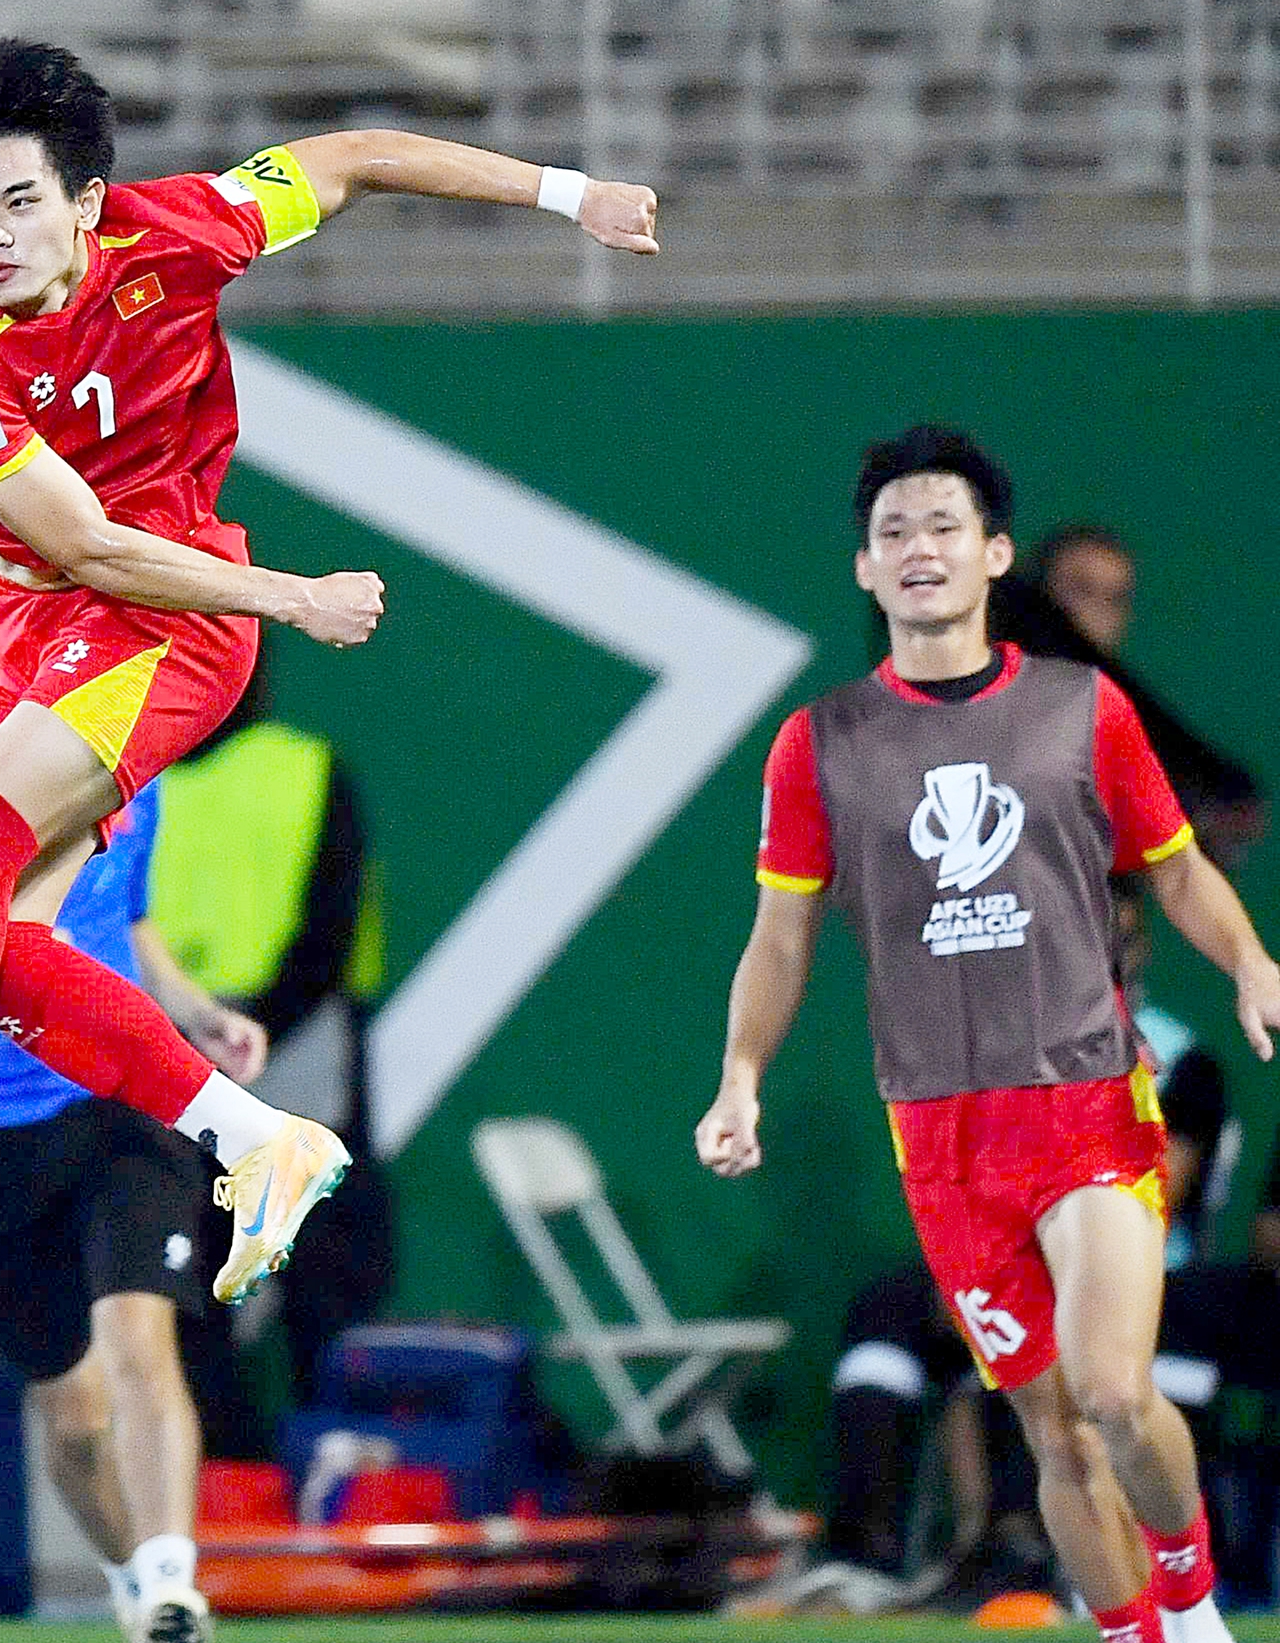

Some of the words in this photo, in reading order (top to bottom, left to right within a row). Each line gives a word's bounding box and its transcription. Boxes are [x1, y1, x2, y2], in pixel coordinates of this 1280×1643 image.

[71, 370, 117, 440] 7
[922, 915, 984, 942] ASIAN
[985, 910, 1032, 934] CUP
[929, 897, 974, 922] AFC
[974, 893, 1018, 916] U23
[954, 1286, 1028, 1364] 15
